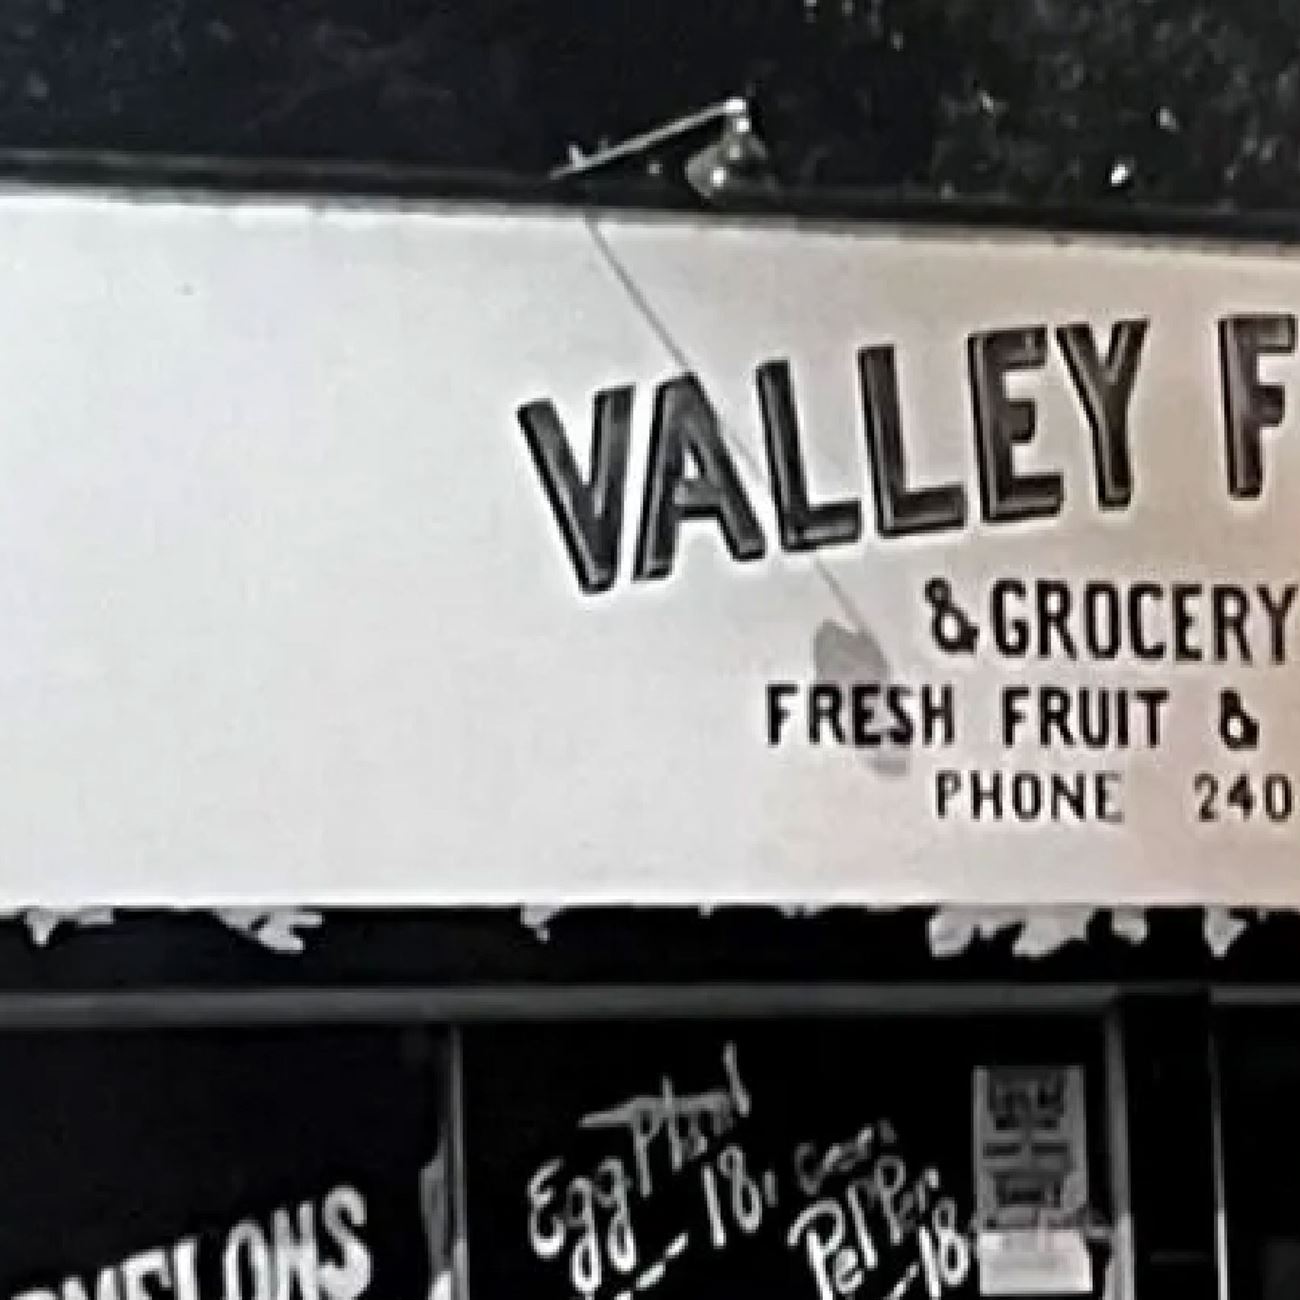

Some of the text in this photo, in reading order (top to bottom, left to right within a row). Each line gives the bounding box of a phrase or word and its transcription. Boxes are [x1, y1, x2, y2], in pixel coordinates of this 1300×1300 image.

[517, 316, 1150, 596] VALLEY
[990, 577, 1300, 665] GROCERY
[766, 684, 956, 748] FRESH
[1002, 688, 1170, 750] FRUIT
[1219, 692, 1260, 750] &
[935, 770, 1295, 822] PHONE 240
